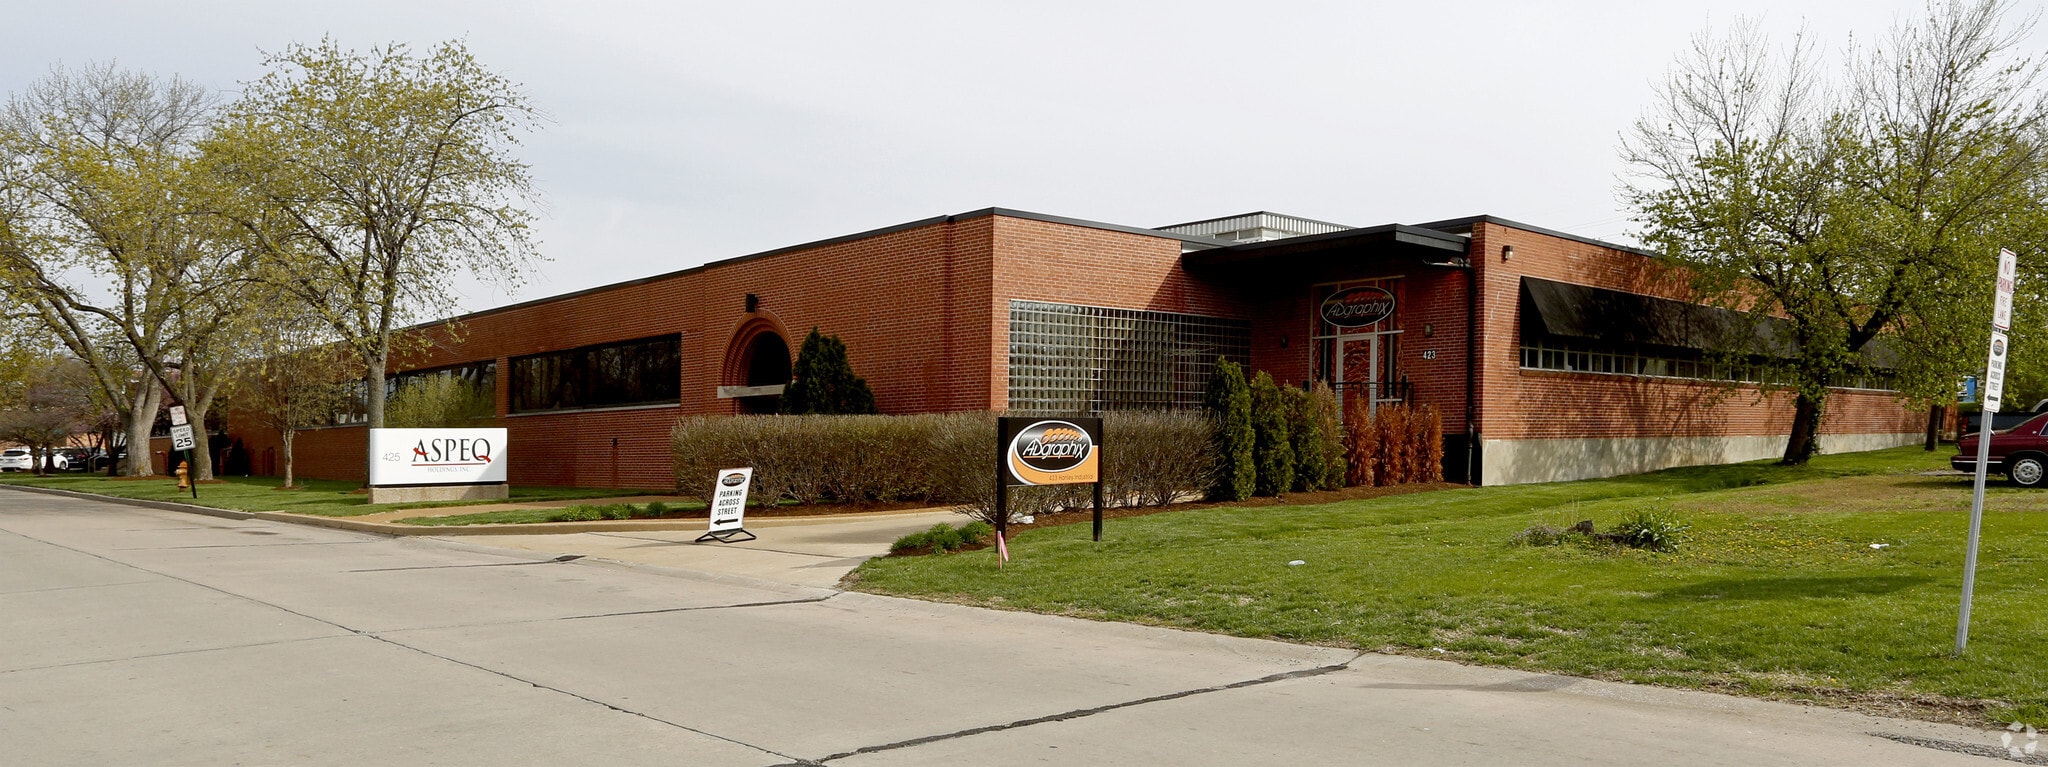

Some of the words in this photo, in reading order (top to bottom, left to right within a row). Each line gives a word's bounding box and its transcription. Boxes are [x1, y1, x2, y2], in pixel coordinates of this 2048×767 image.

[1422, 350, 1436, 360] 423
[176, 437, 192, 448] 25
[412, 438, 492, 463] ASPEQ
[382, 452, 401, 462] 425
[719, 489, 743, 498] PARKING
[718, 498, 740, 507] ACROSS
[717, 507, 738, 516] STREET
